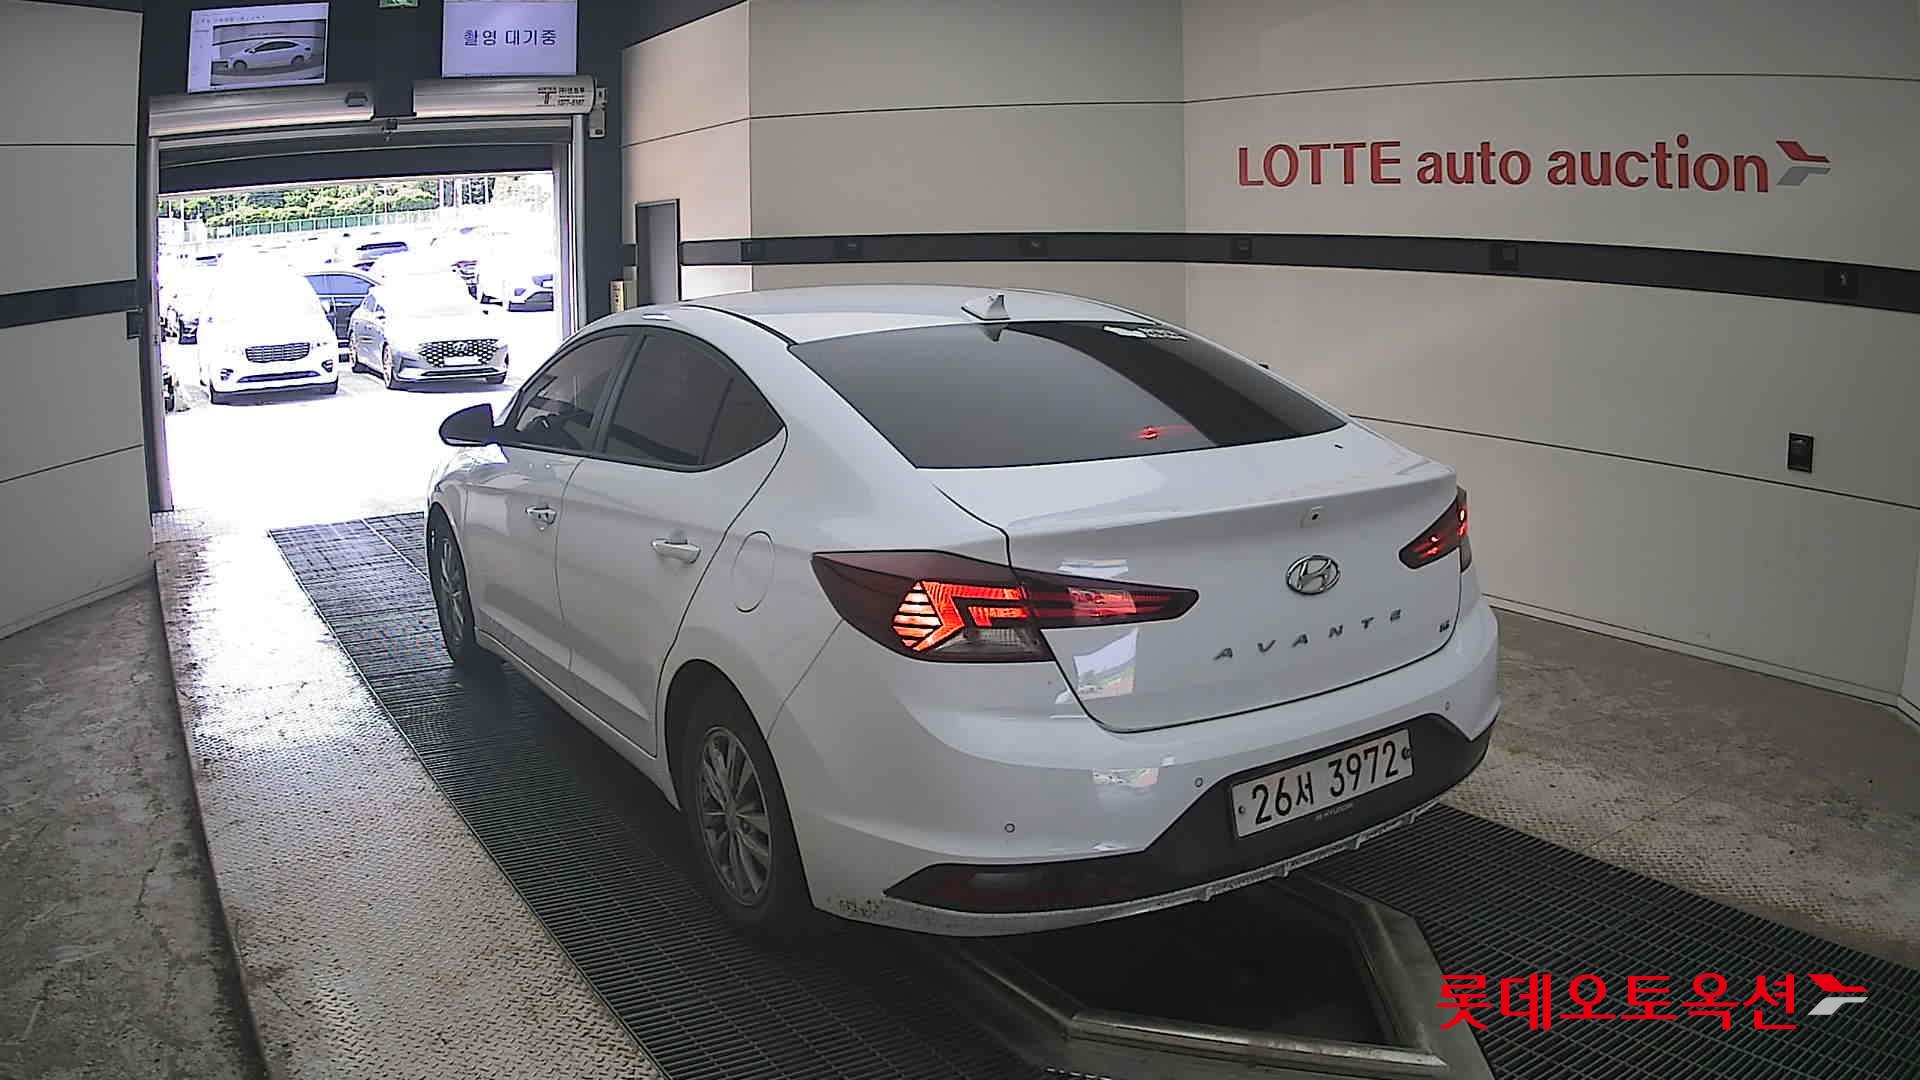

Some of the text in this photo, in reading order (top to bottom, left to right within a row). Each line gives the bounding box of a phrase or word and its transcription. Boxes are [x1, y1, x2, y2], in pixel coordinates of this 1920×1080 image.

[505, 29, 557, 46] 대기중
[1238, 133, 1769, 193] LOTTE auto auction
[1213, 609, 1402, 660] AVANTE
[1252, 740, 1399, 825] 26서 3972
